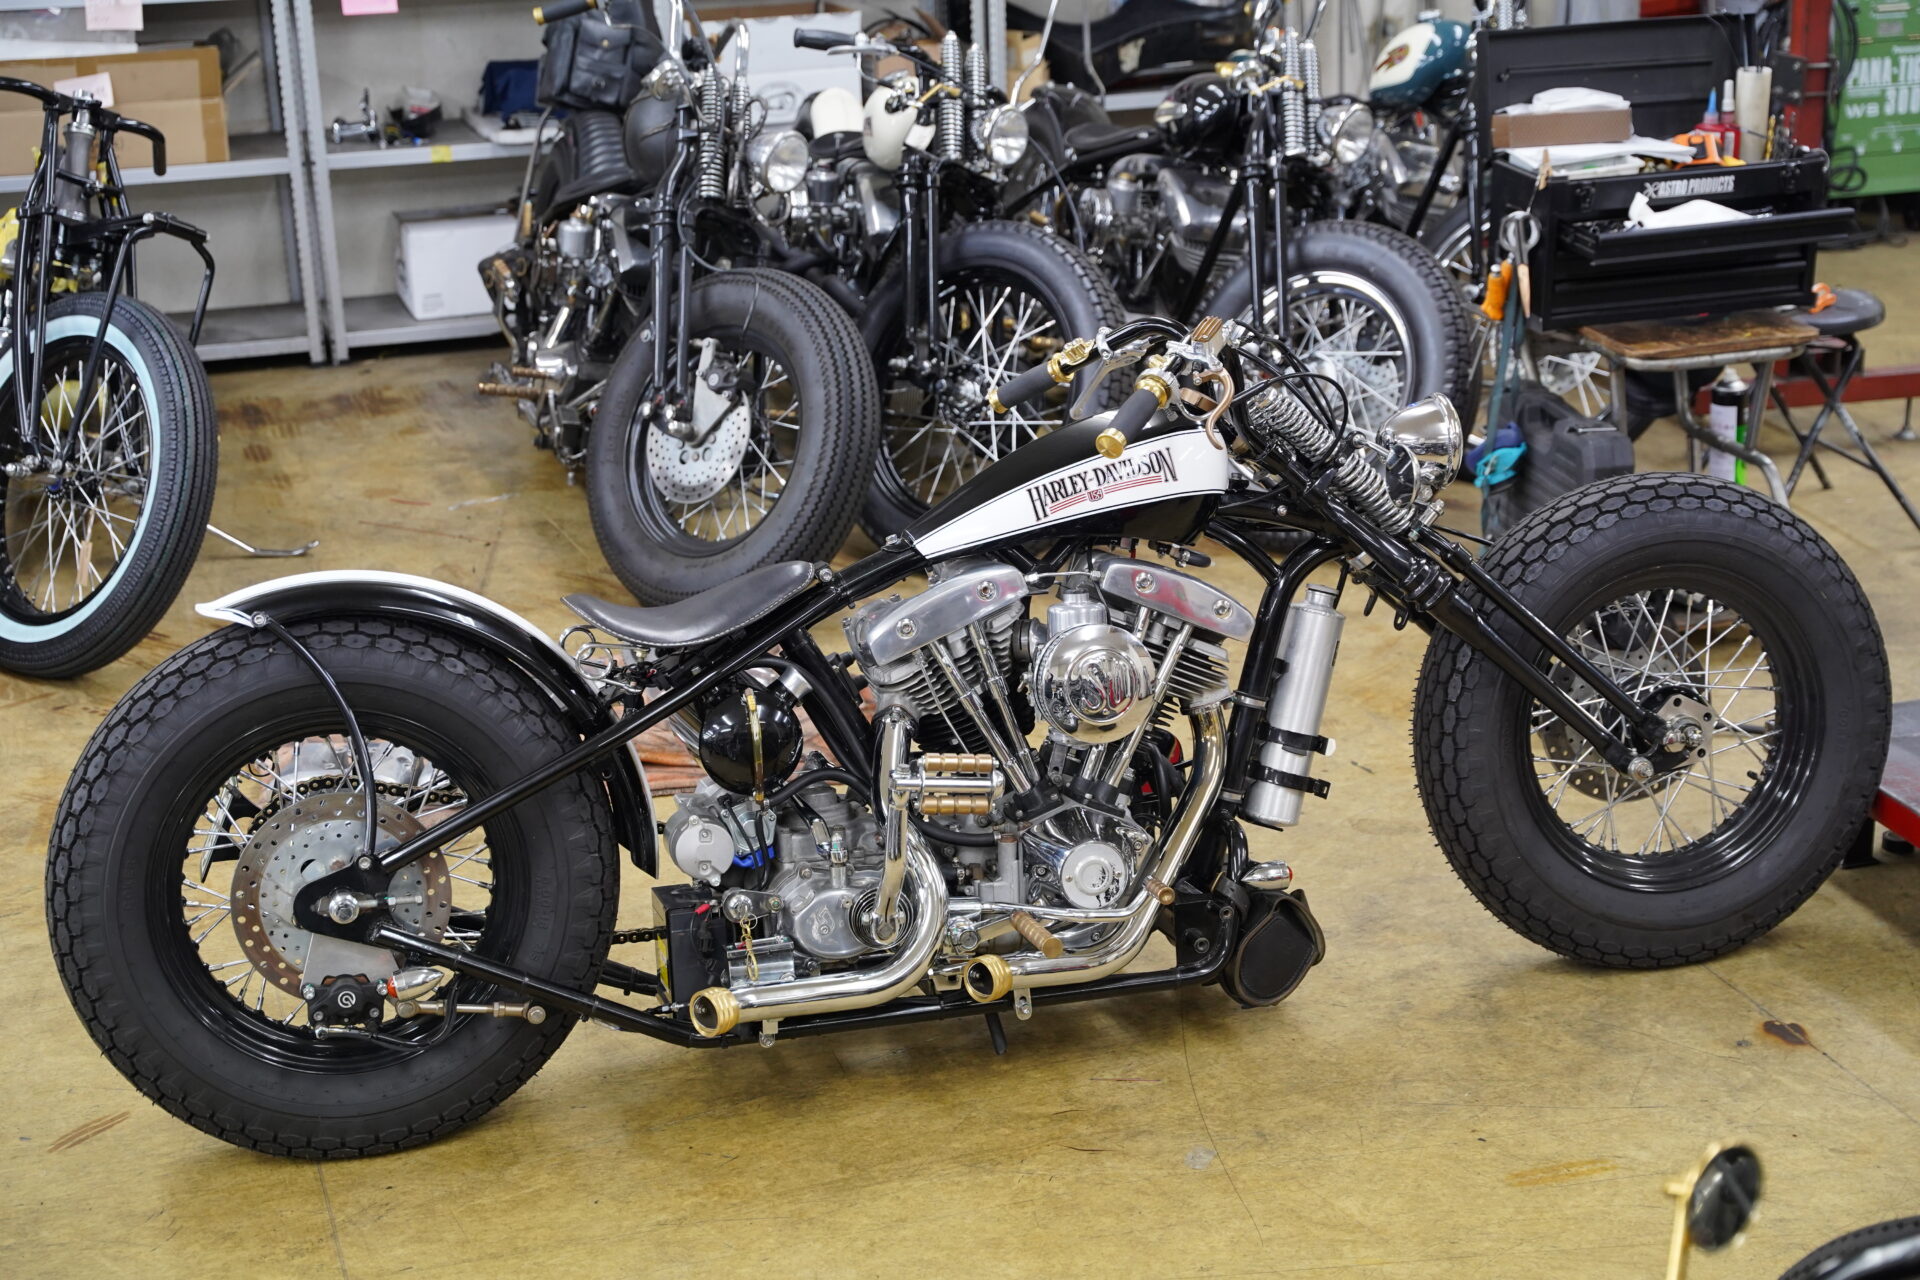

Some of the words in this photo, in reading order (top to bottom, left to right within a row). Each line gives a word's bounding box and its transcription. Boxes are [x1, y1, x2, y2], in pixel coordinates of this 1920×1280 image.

[1658, 179, 1688, 197] ASTRO
[1688, 175, 1735, 195] PRODUCTS
[1026, 447, 1179, 521] HARLEY-DAVIDSON
